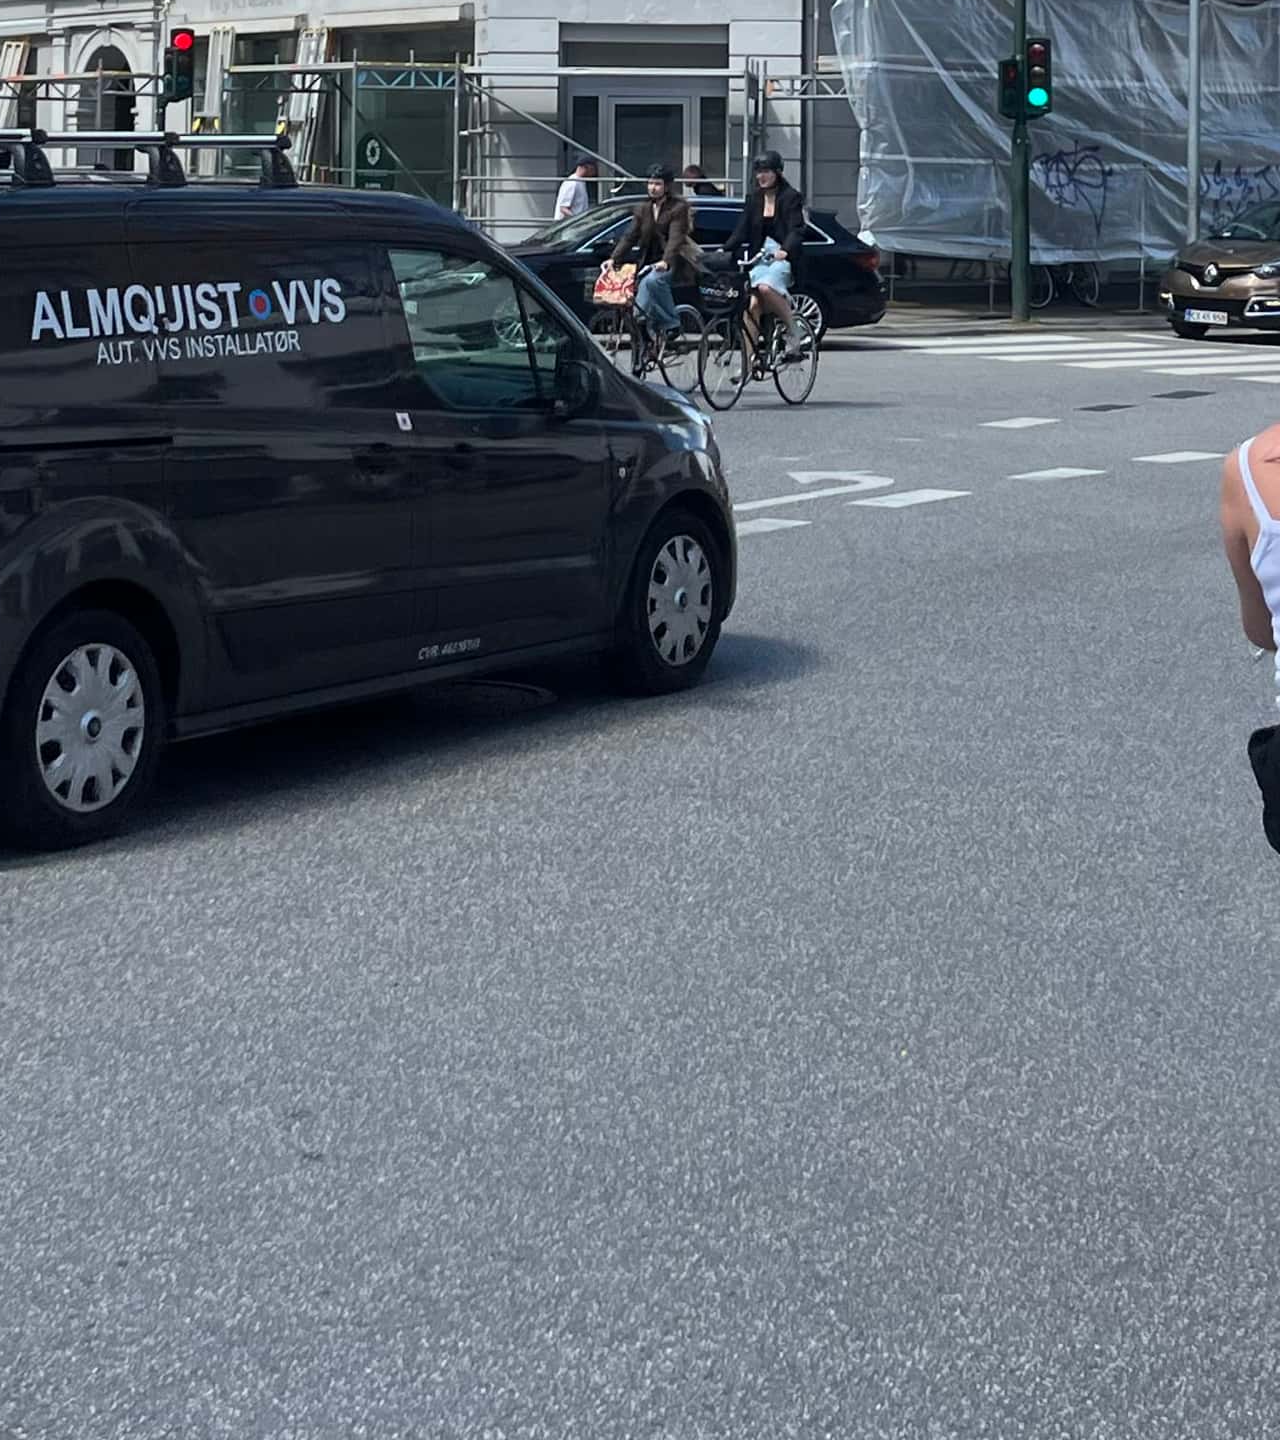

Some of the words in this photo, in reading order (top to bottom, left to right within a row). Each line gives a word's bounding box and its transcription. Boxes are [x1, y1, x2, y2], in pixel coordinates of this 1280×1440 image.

[31, 282, 242, 341] ALMQUIST
[271, 277, 346, 325] VVS
[96, 340, 140, 365] AUT.
[144, 337, 182, 360] VVS
[186, 330, 302, 359] INSTALLATØR
